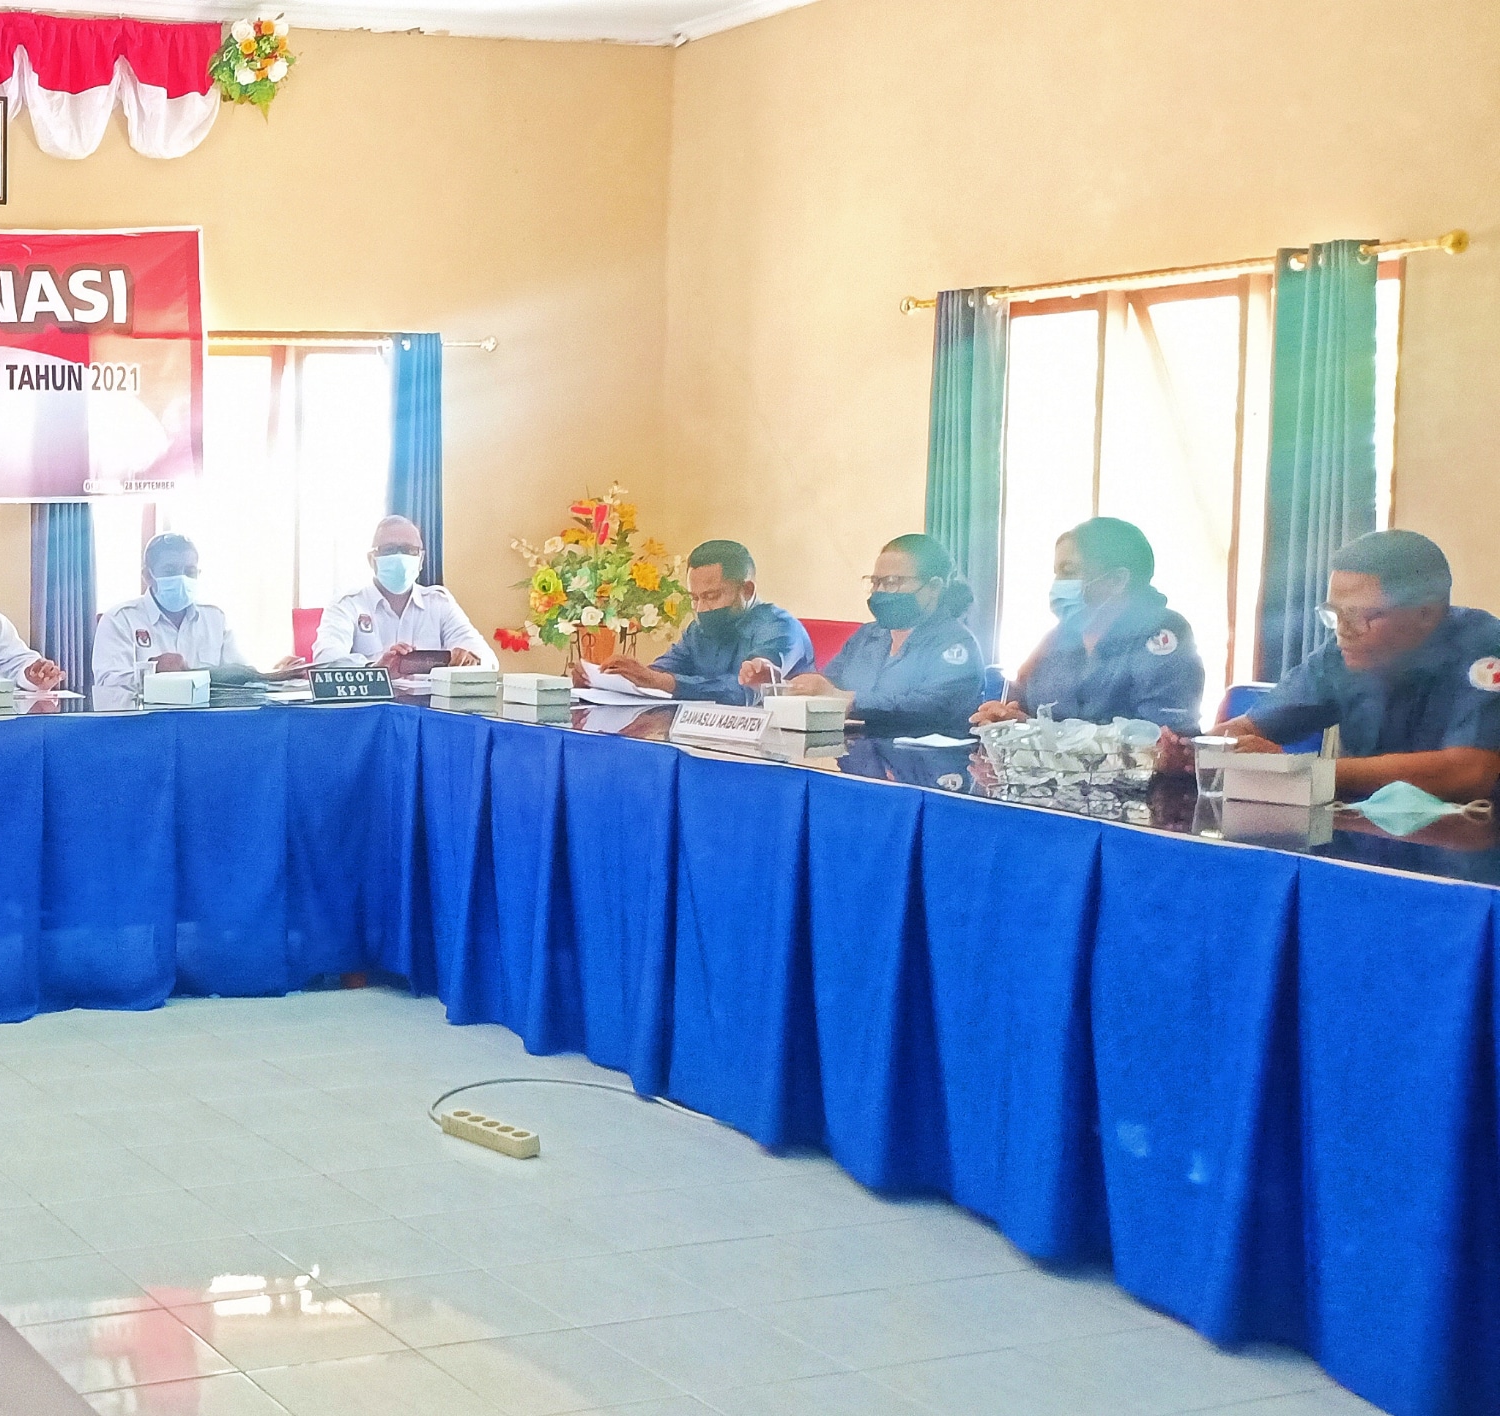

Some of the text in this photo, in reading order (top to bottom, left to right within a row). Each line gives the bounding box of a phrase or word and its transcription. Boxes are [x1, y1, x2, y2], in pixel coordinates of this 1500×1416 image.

[5, 364, 83, 391] TAHUN
[91, 364, 139, 392] 2021
[134, 481, 176, 490] SEPTEMBER
[315, 671, 386, 683] ANGGOTA
[336, 685, 369, 697] KPU
[680, 710, 765, 732] BAWASLU KABUPATEN
